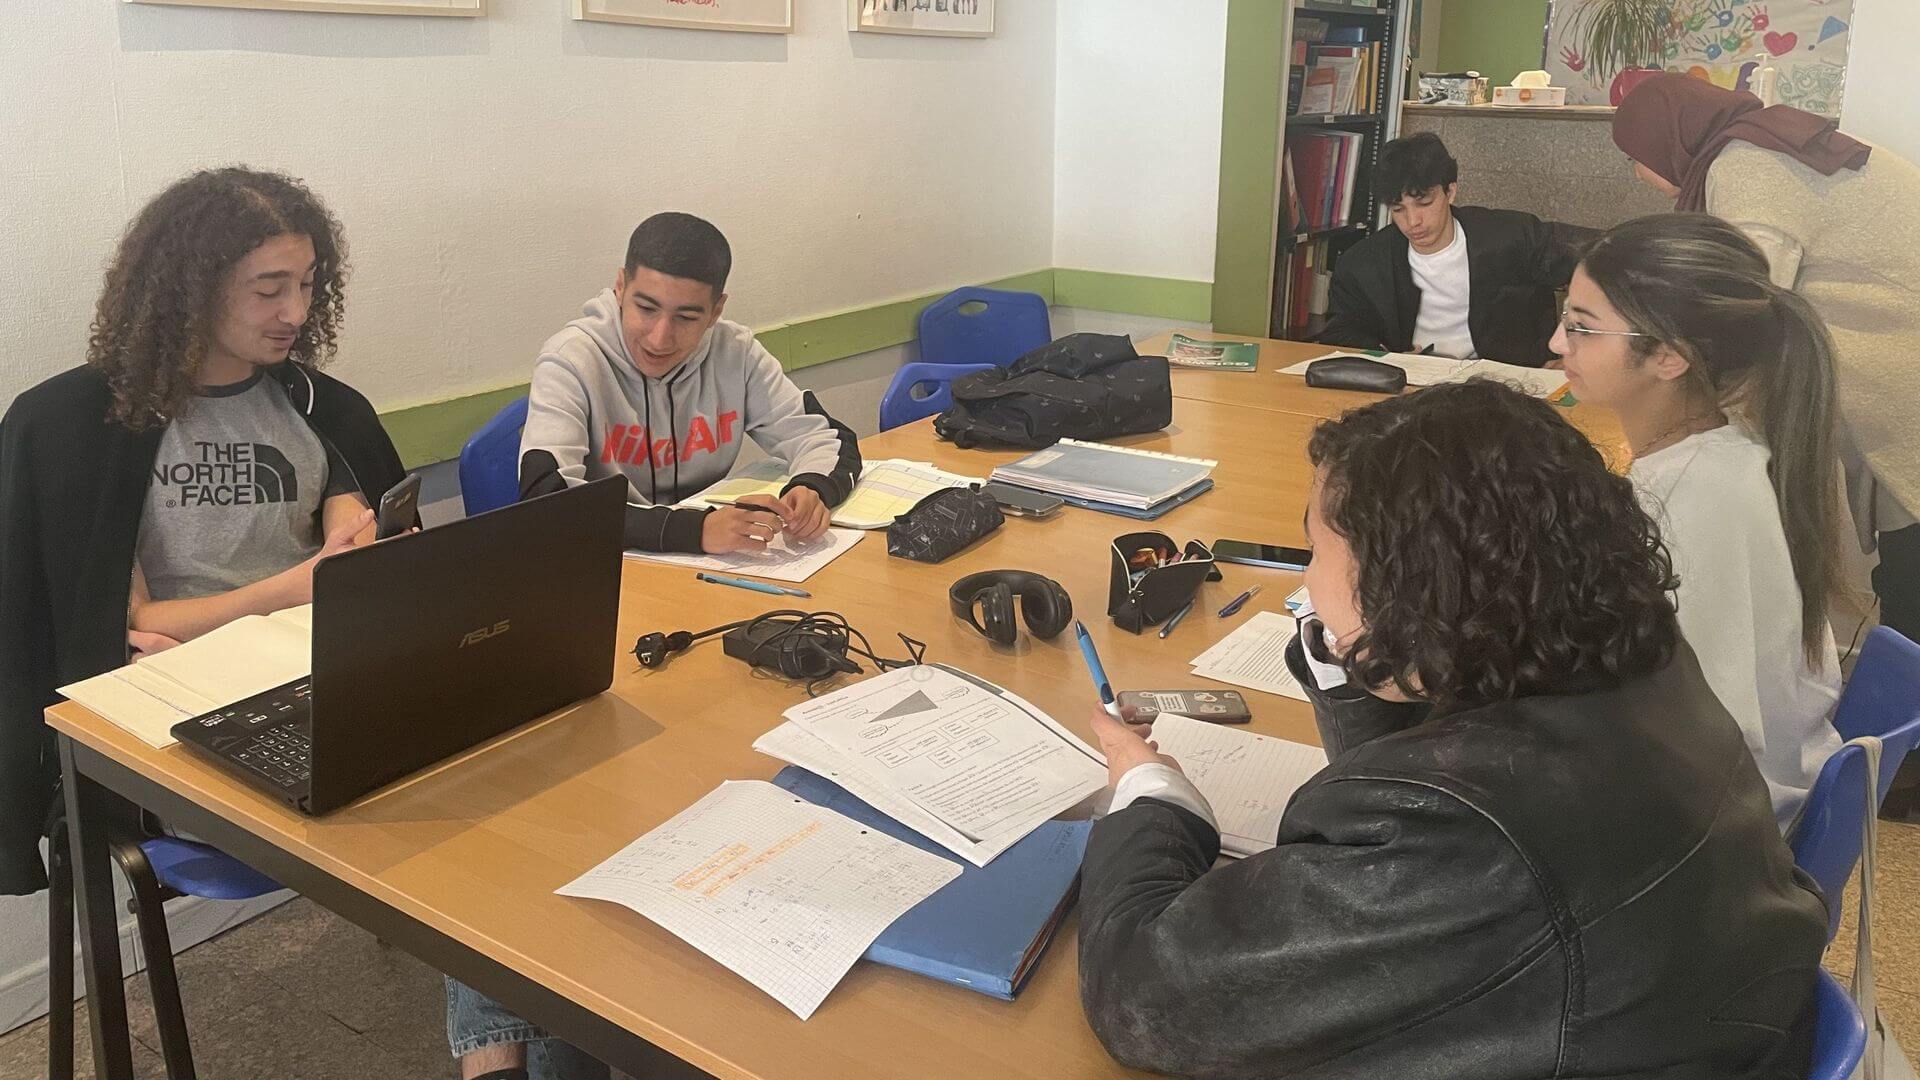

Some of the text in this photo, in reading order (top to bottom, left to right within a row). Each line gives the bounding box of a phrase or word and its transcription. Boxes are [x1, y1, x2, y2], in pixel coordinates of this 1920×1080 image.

[195, 441, 252, 463] THE
[151, 462, 250, 487] NORTH
[181, 484, 252, 507] FACE
[459, 619, 510, 648] ASUS
